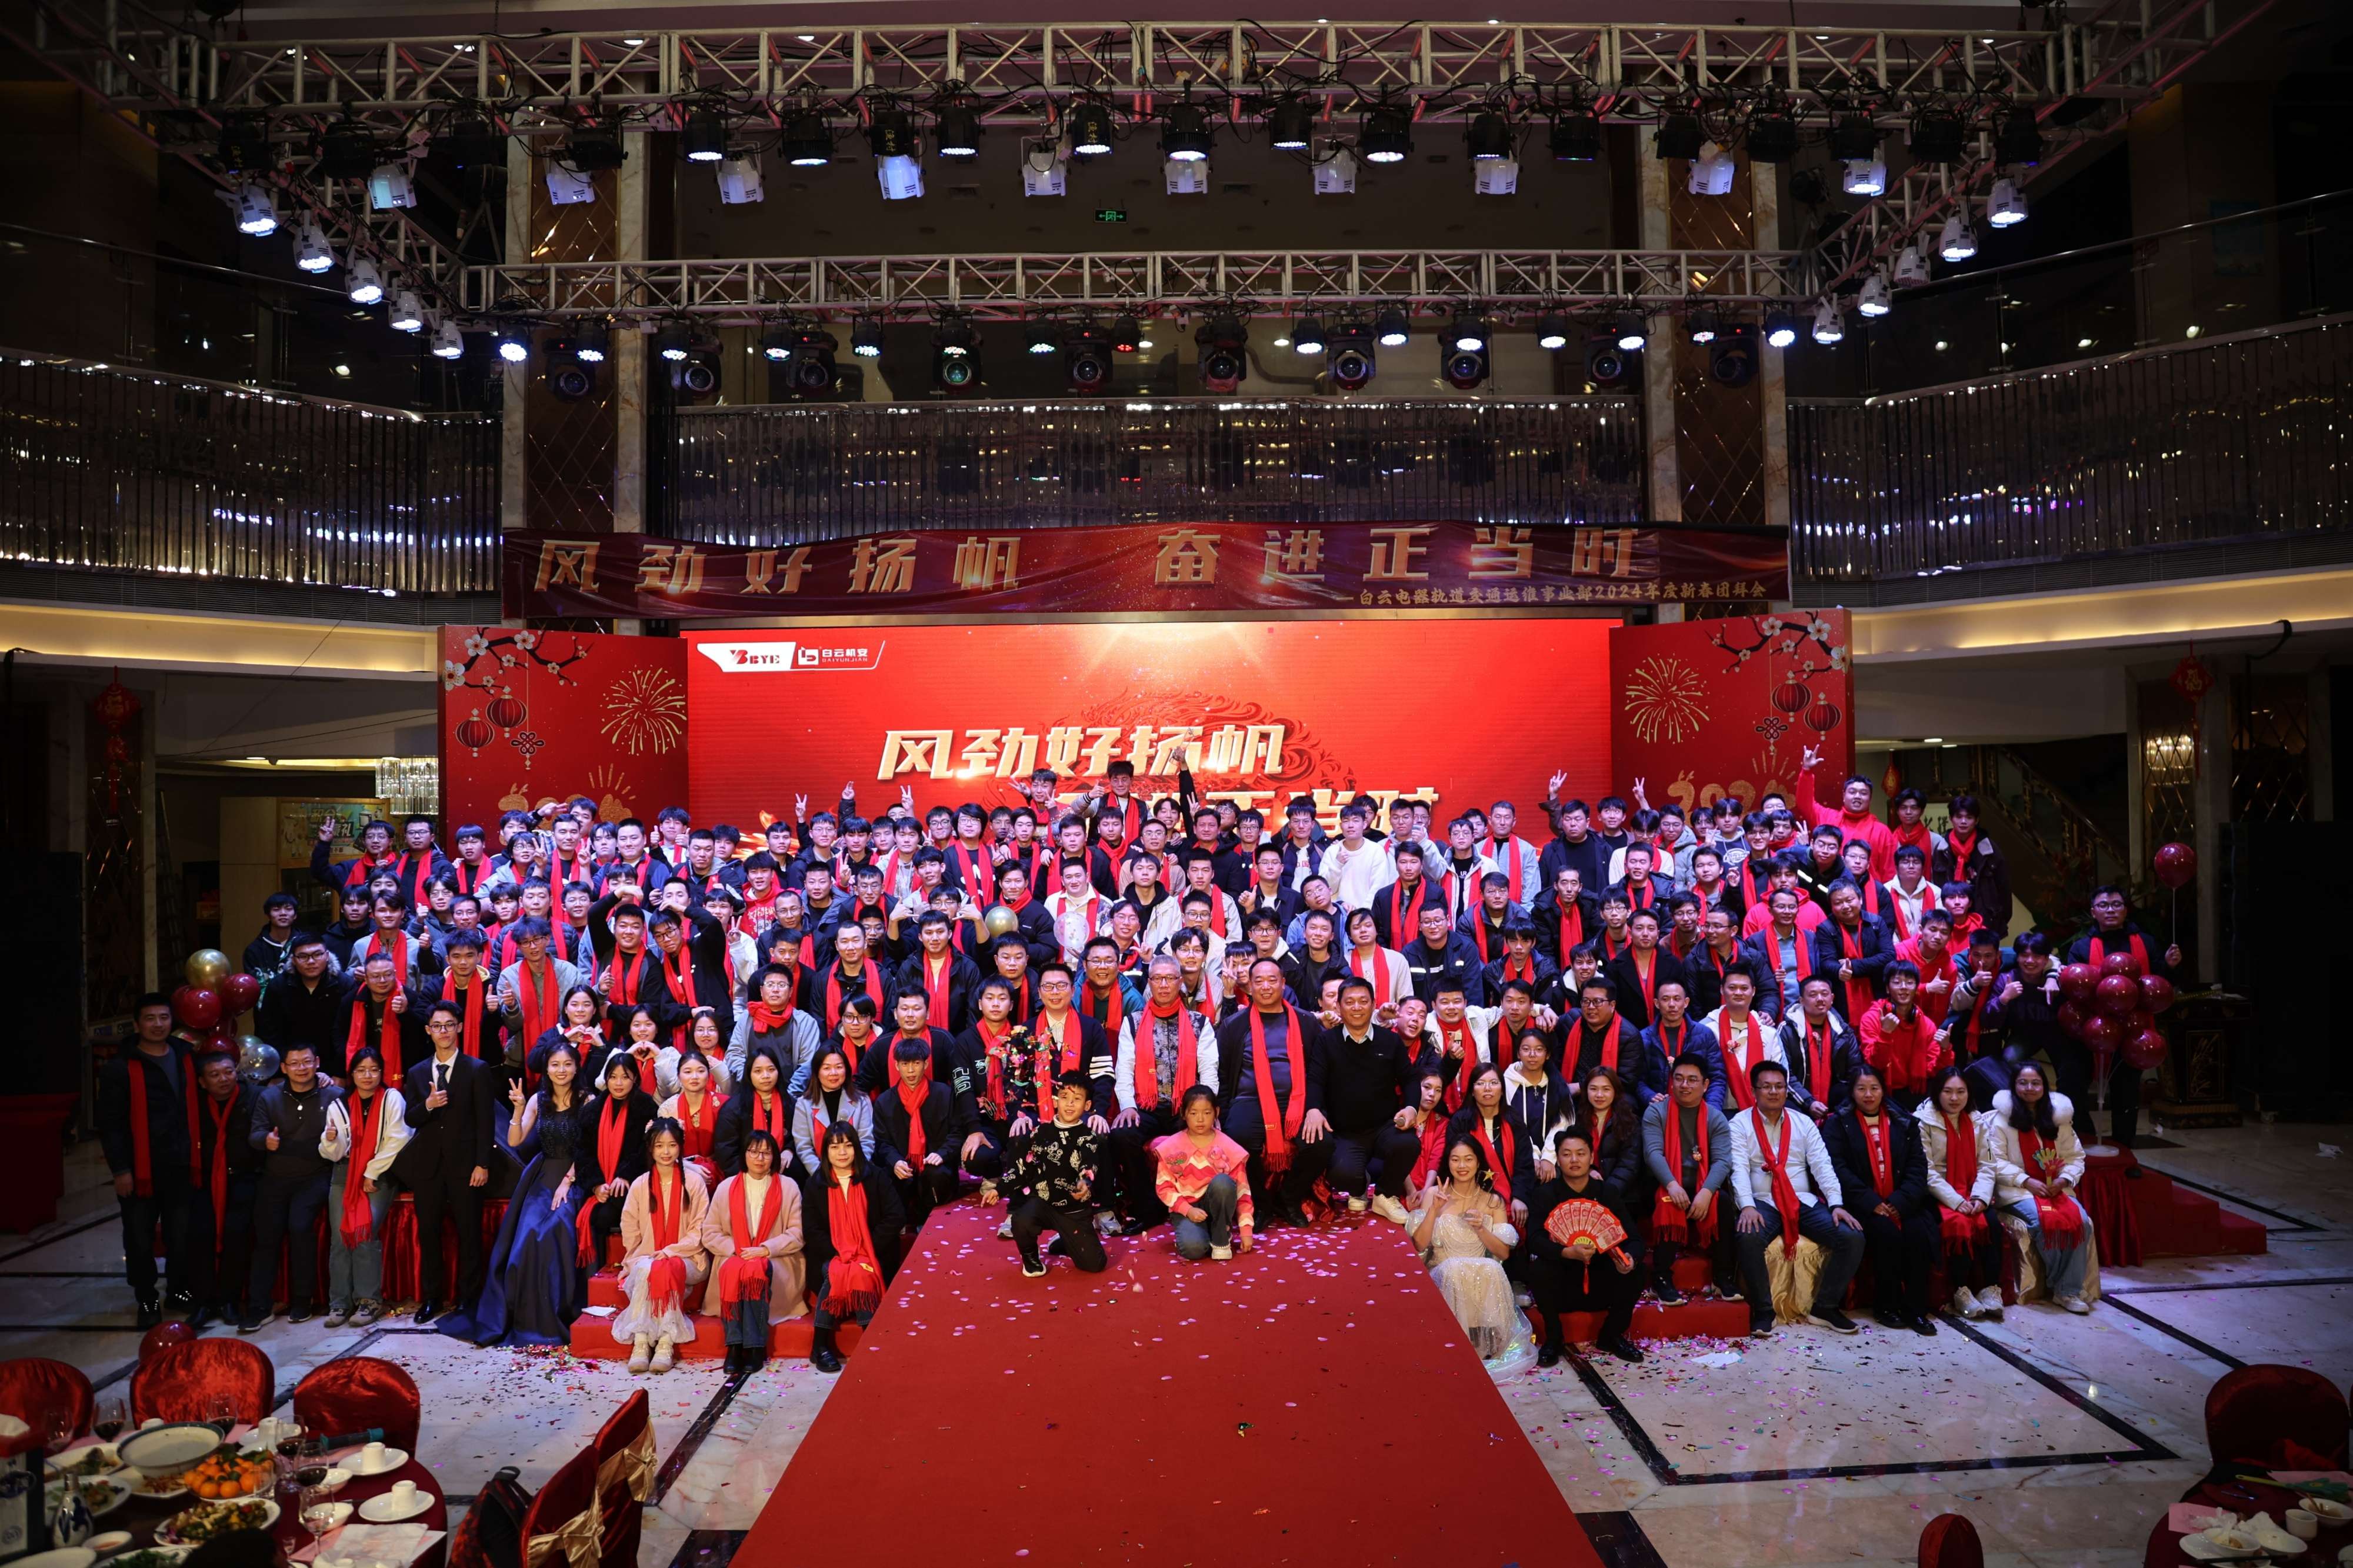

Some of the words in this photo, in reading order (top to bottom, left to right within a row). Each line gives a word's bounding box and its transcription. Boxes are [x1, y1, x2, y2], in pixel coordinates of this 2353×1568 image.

[534, 536, 1021, 594] 风劲好扬帆
[1154, 526, 1639, 586] 奋进正当时
[876, 724, 1285, 780] 风劲好扬帆
